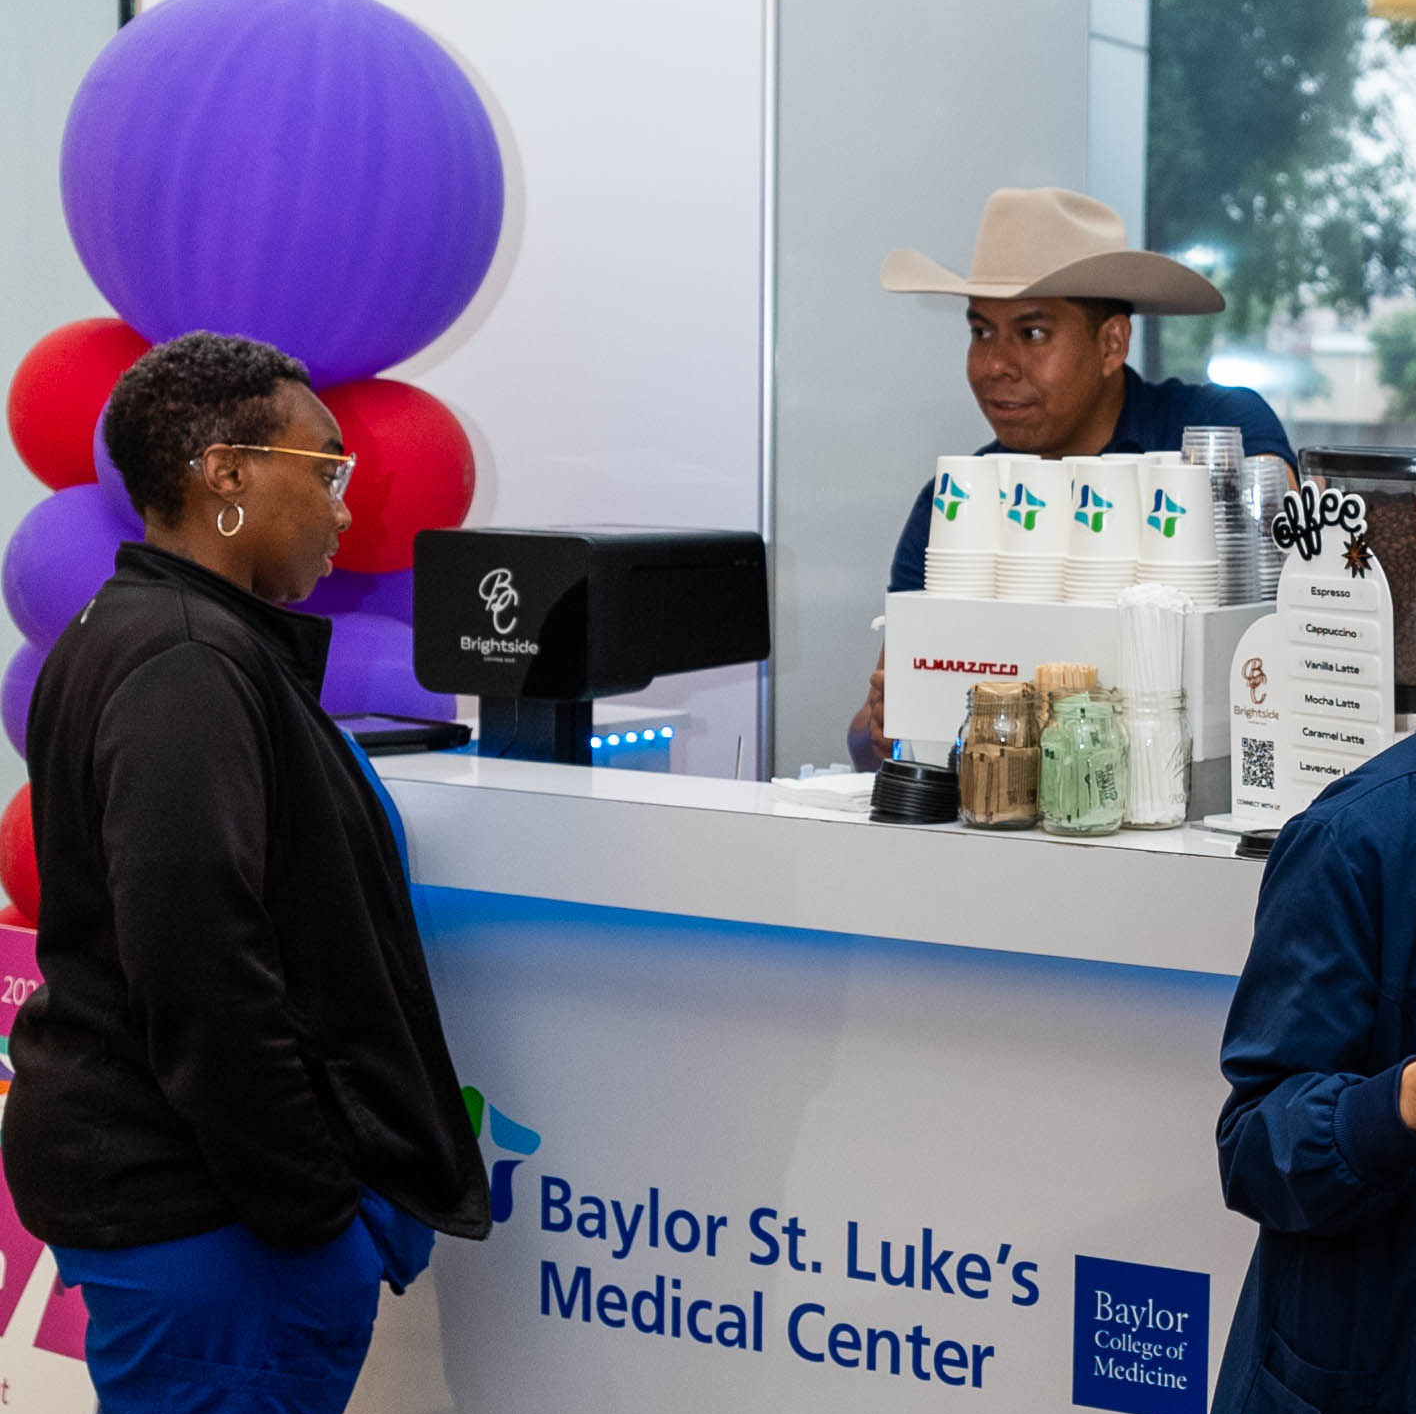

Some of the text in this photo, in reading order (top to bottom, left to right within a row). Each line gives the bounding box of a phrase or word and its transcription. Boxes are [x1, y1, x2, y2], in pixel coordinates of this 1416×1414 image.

[1310, 586, 1351, 599] Espresso
[1305, 623, 1357, 639] Cappuccino
[460, 635, 539, 655] Brightside
[1304, 659, 1360, 675] Vanilla Latte
[1304, 694, 1360, 710] Mocha Latte
[1302, 727, 1365, 745] Caramel Latte
[1299, 761, 1341, 776] Lavender
[541, 1175, 1040, 1306] Baylor St. Luke’s
[1093, 1290, 1189, 1333] Baylor
[541, 1260, 995, 1388] Medical Center
[1094, 1329, 1188, 1361] College of
[1093, 1355, 1188, 1390] Medicine
